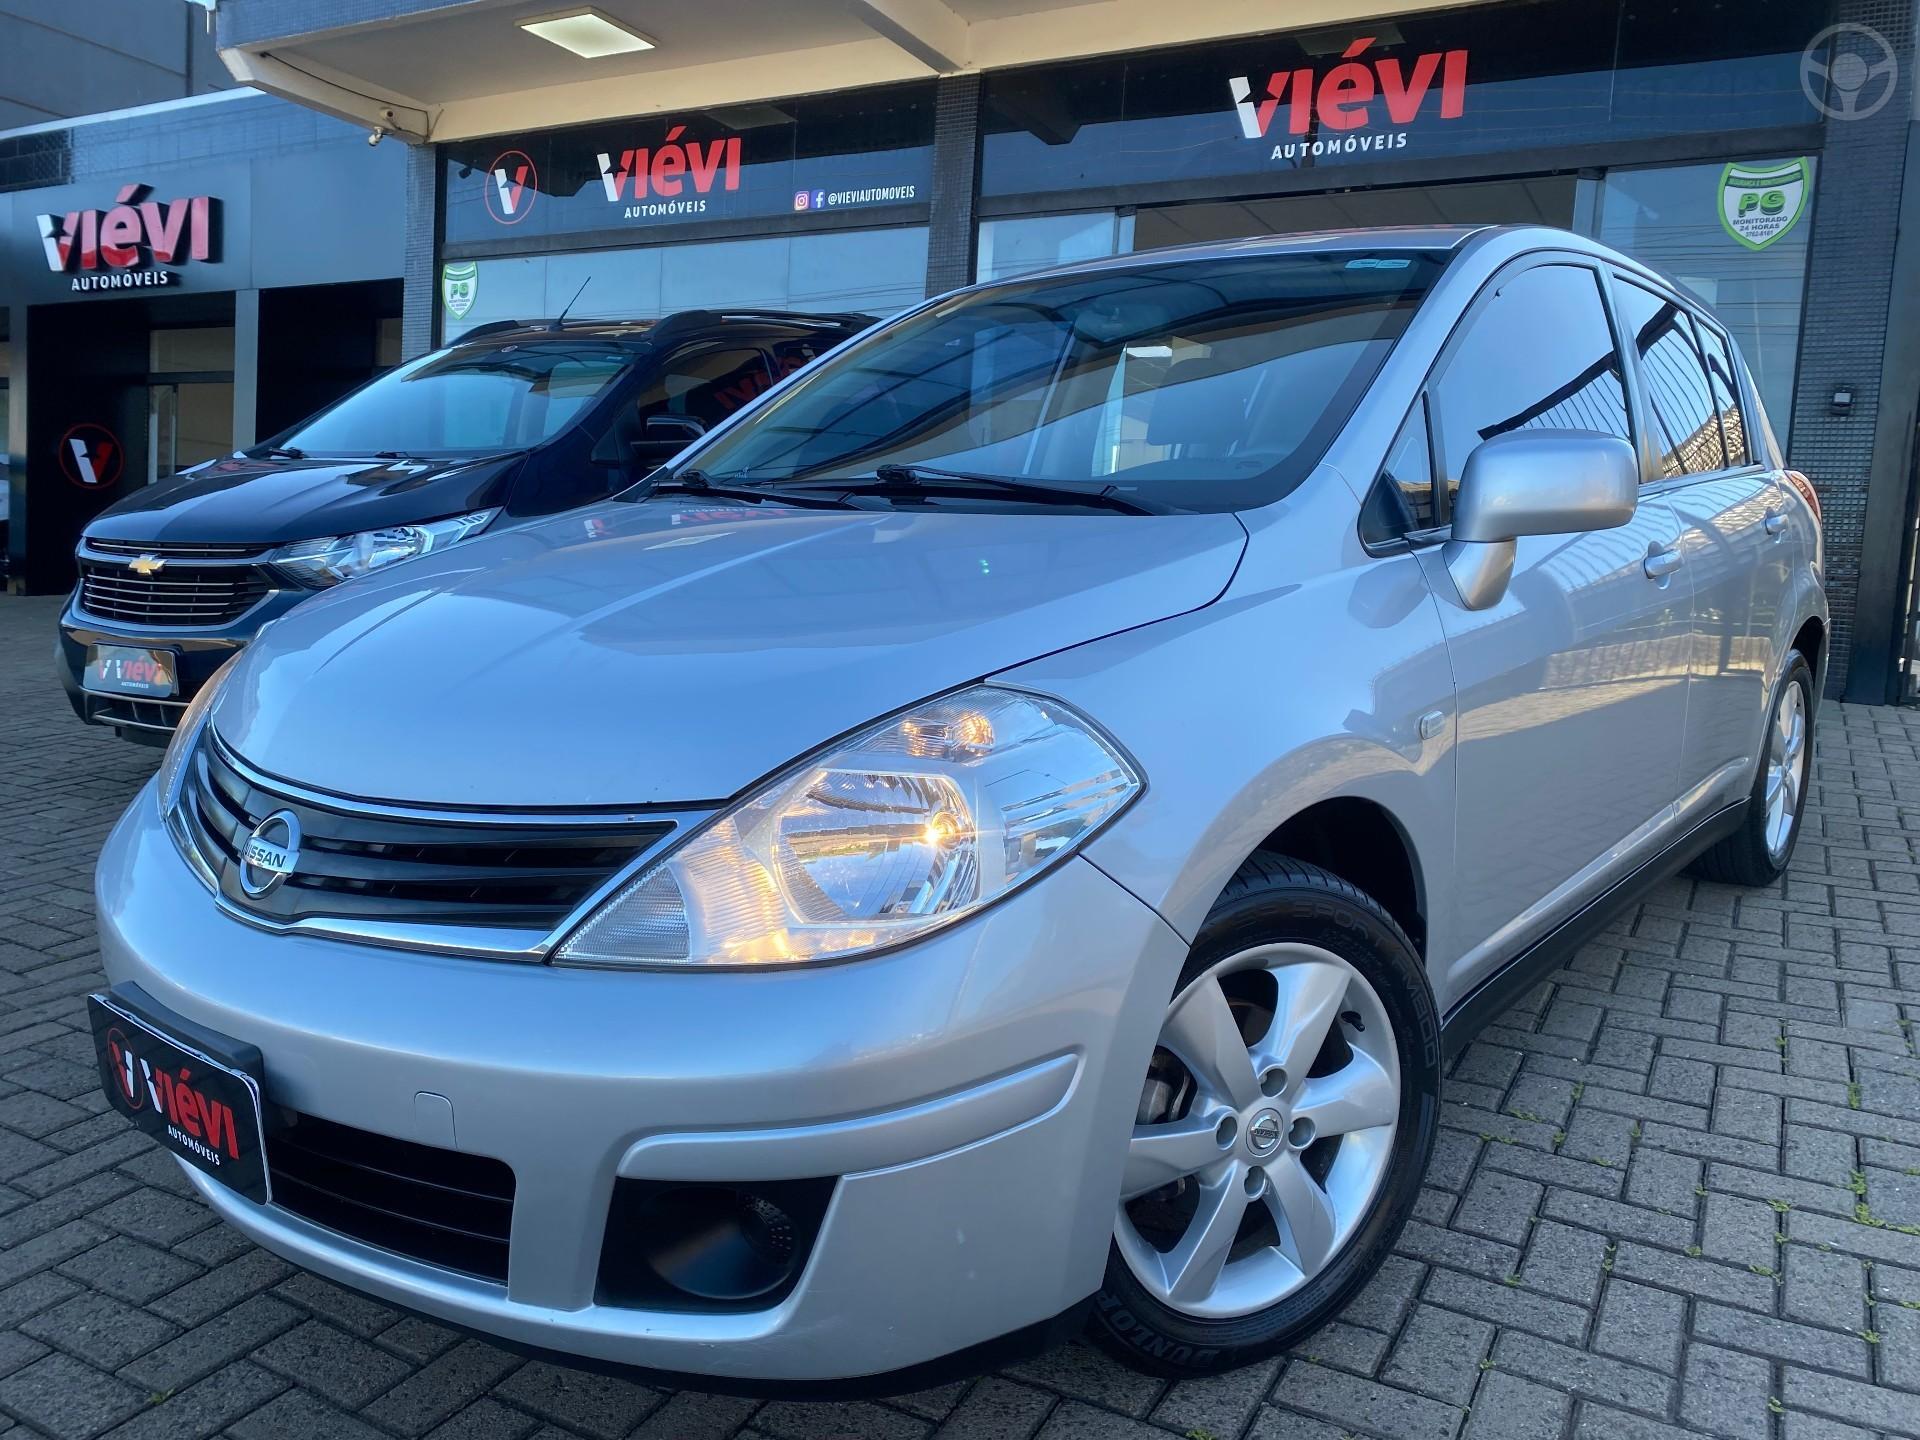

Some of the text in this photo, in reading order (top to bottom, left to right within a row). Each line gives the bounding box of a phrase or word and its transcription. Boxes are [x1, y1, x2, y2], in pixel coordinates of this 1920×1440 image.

[1271, 133, 1408, 160] AUTOMÓVEIS
[828, 185, 915, 205] @VIEVIAUTOMOVEIS
[624, 200, 706, 218] AUTOMÓVEIS
[1733, 216, 1788, 225] MONITORADO
[72, 269, 168, 291] AUTOMÓVEIS
[168, 1124, 221, 1167] AUTOMÓVEIS
